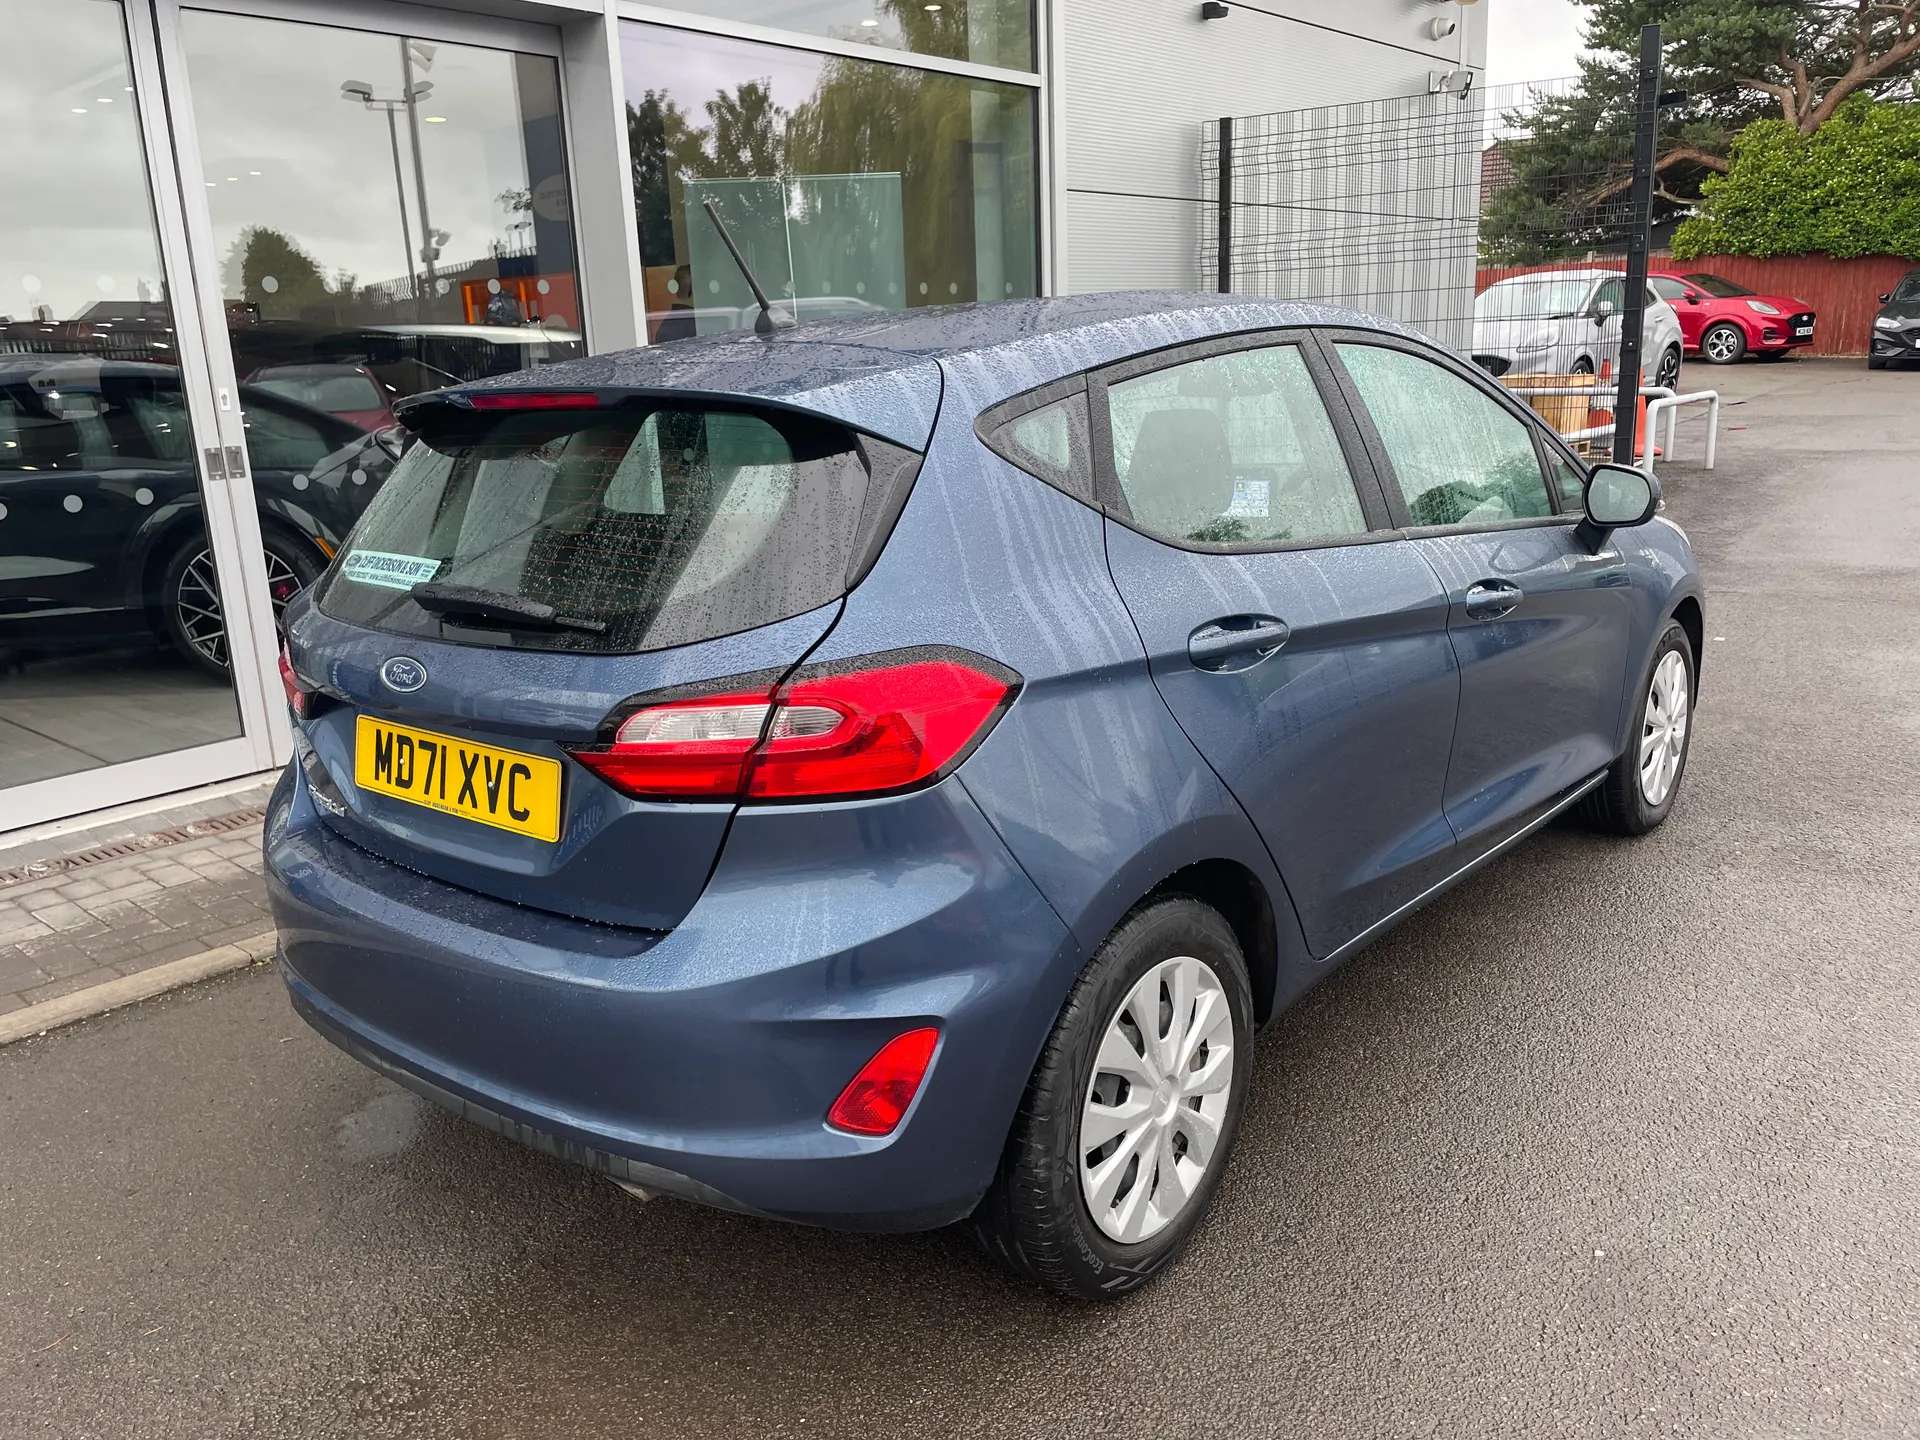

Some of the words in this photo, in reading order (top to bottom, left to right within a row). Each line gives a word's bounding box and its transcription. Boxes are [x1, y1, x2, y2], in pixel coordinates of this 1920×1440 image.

[390, 663, 416, 684] Ford
[374, 728, 447, 800] MD71
[457, 749, 532, 822] XVC
